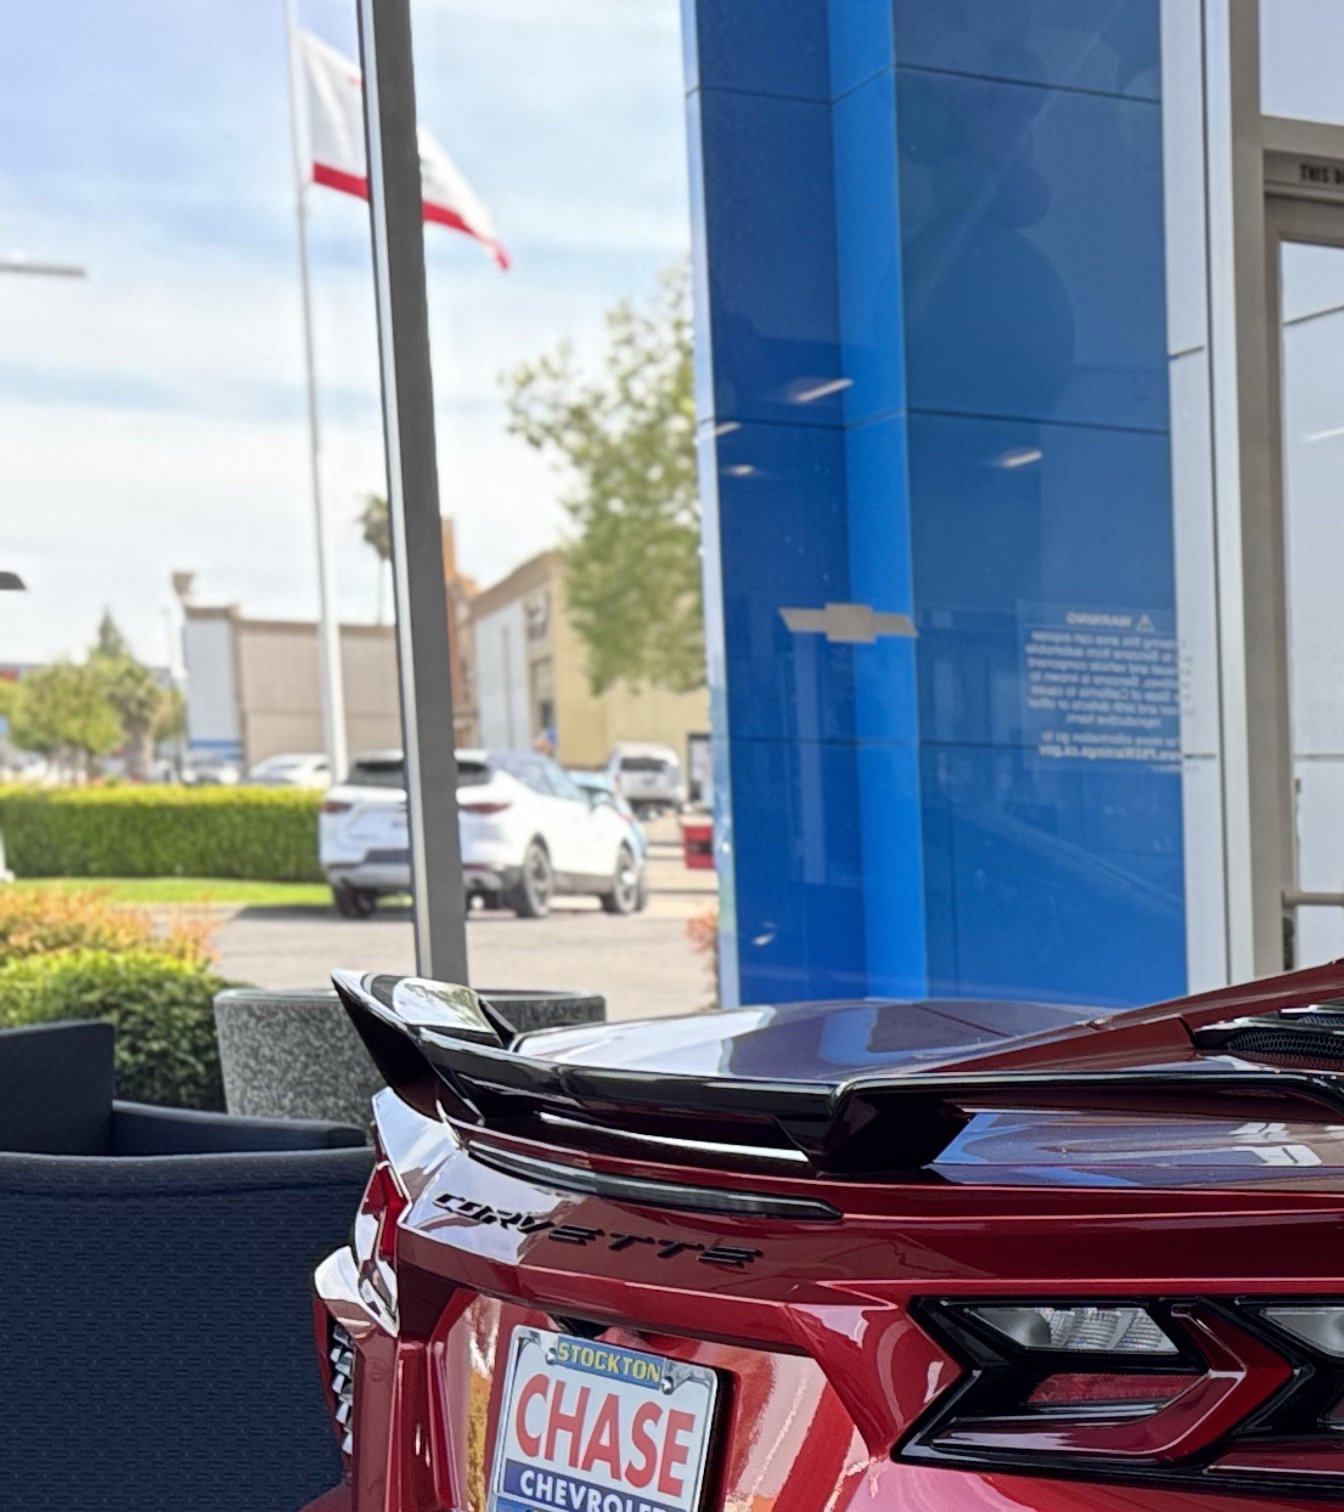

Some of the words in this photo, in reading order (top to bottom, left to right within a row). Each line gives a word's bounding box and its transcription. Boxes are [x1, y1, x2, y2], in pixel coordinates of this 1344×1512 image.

[1300, 163, 1329, 184] THIS
[432, 1193, 764, 1269] CORVETTE
[555, 1342, 661, 1383] STOCKTON
[515, 1373, 696, 1497] CHASE
